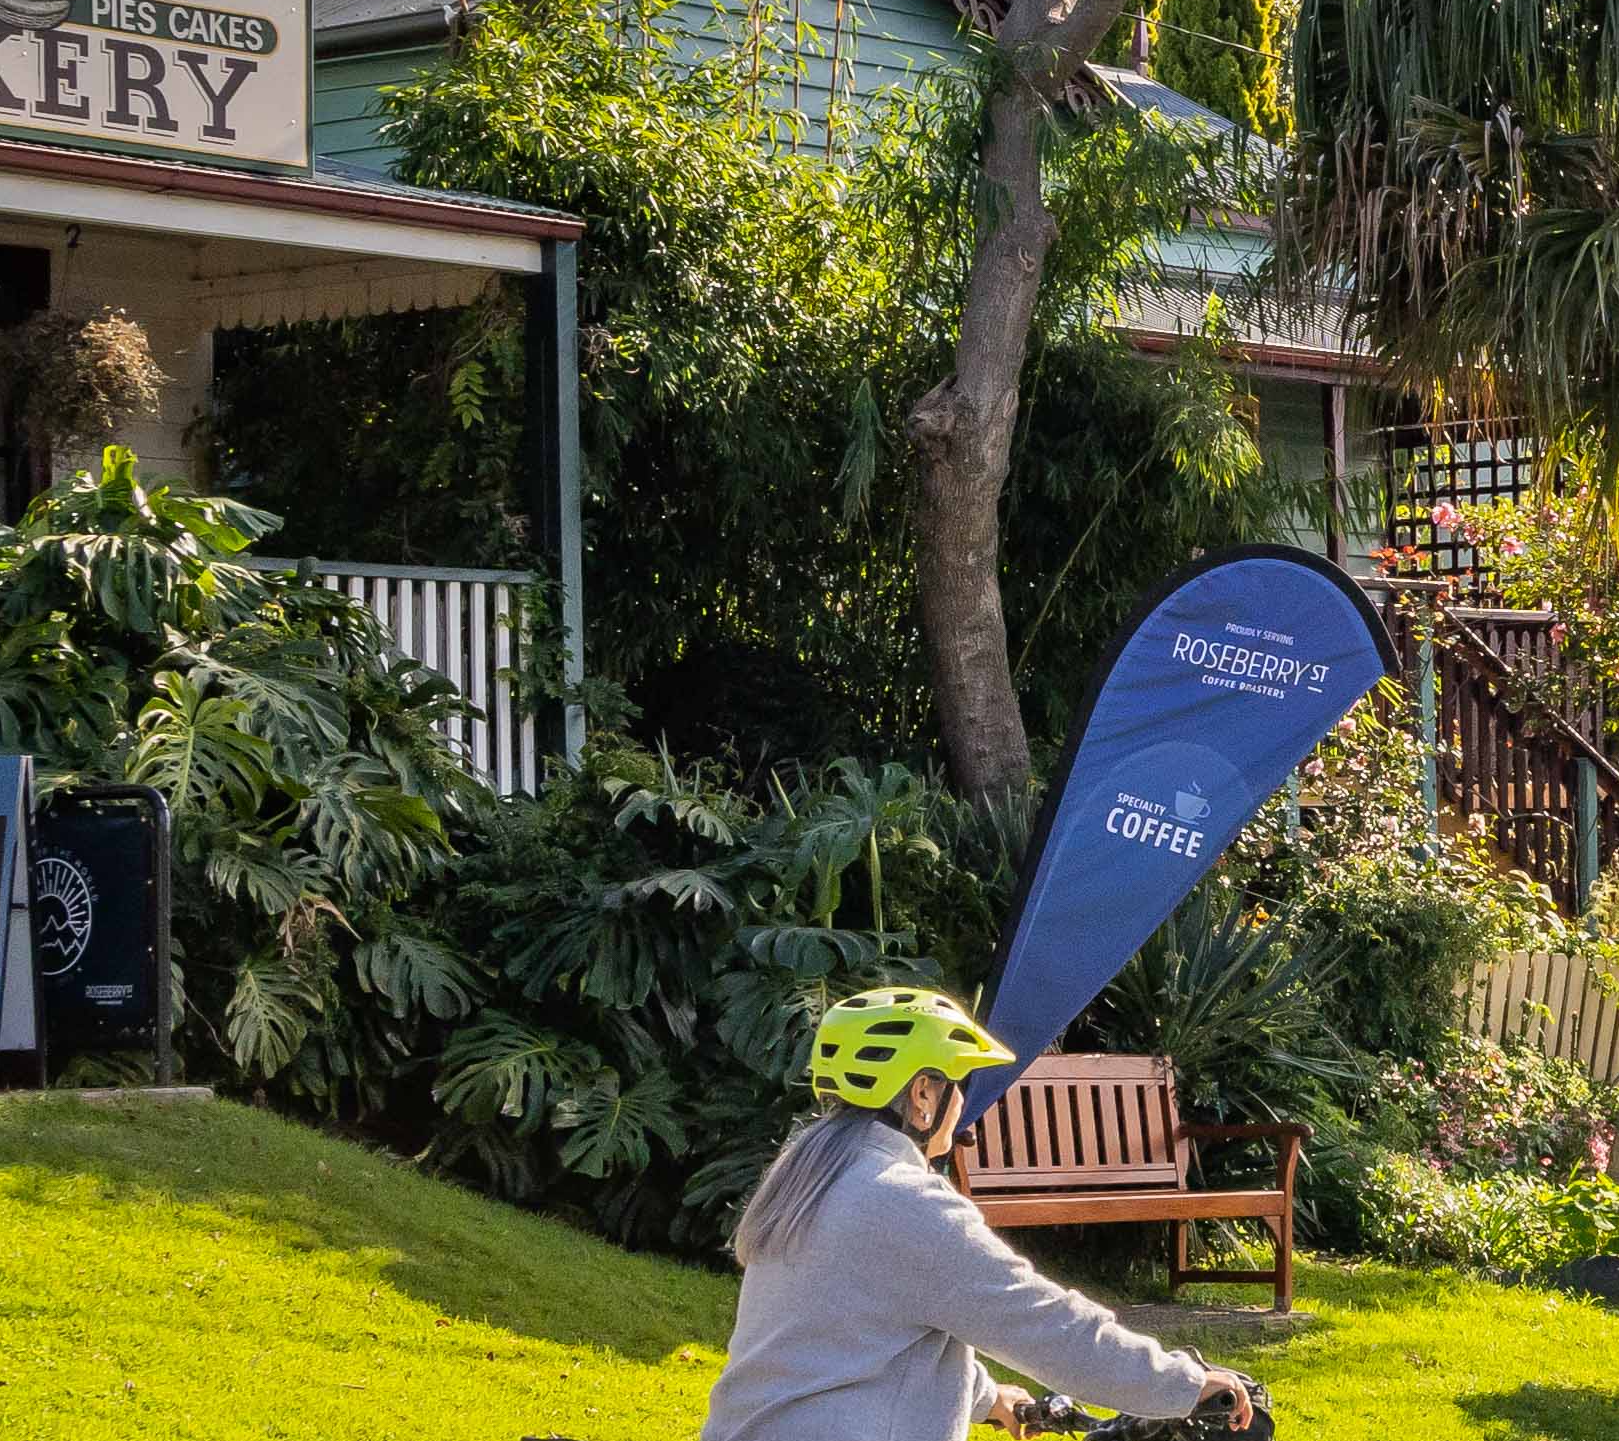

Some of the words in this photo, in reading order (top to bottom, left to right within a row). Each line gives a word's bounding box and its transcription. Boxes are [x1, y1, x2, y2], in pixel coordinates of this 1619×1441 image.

[168, 6, 265, 52] CAKES
[1225, 622, 1262, 638] PROUDLY
[1262, 630, 1294, 646] SERVING
[1172, 632, 1311, 686] ROSEBERRY
[1308, 664, 1330, 693] ST
[1201, 674, 1237, 689] COFFEE
[1239, 681, 1286, 700] ROASTERS
[1117, 792, 1167, 817] SPECIALTY
[1106, 807, 1204, 858] COFFEE
